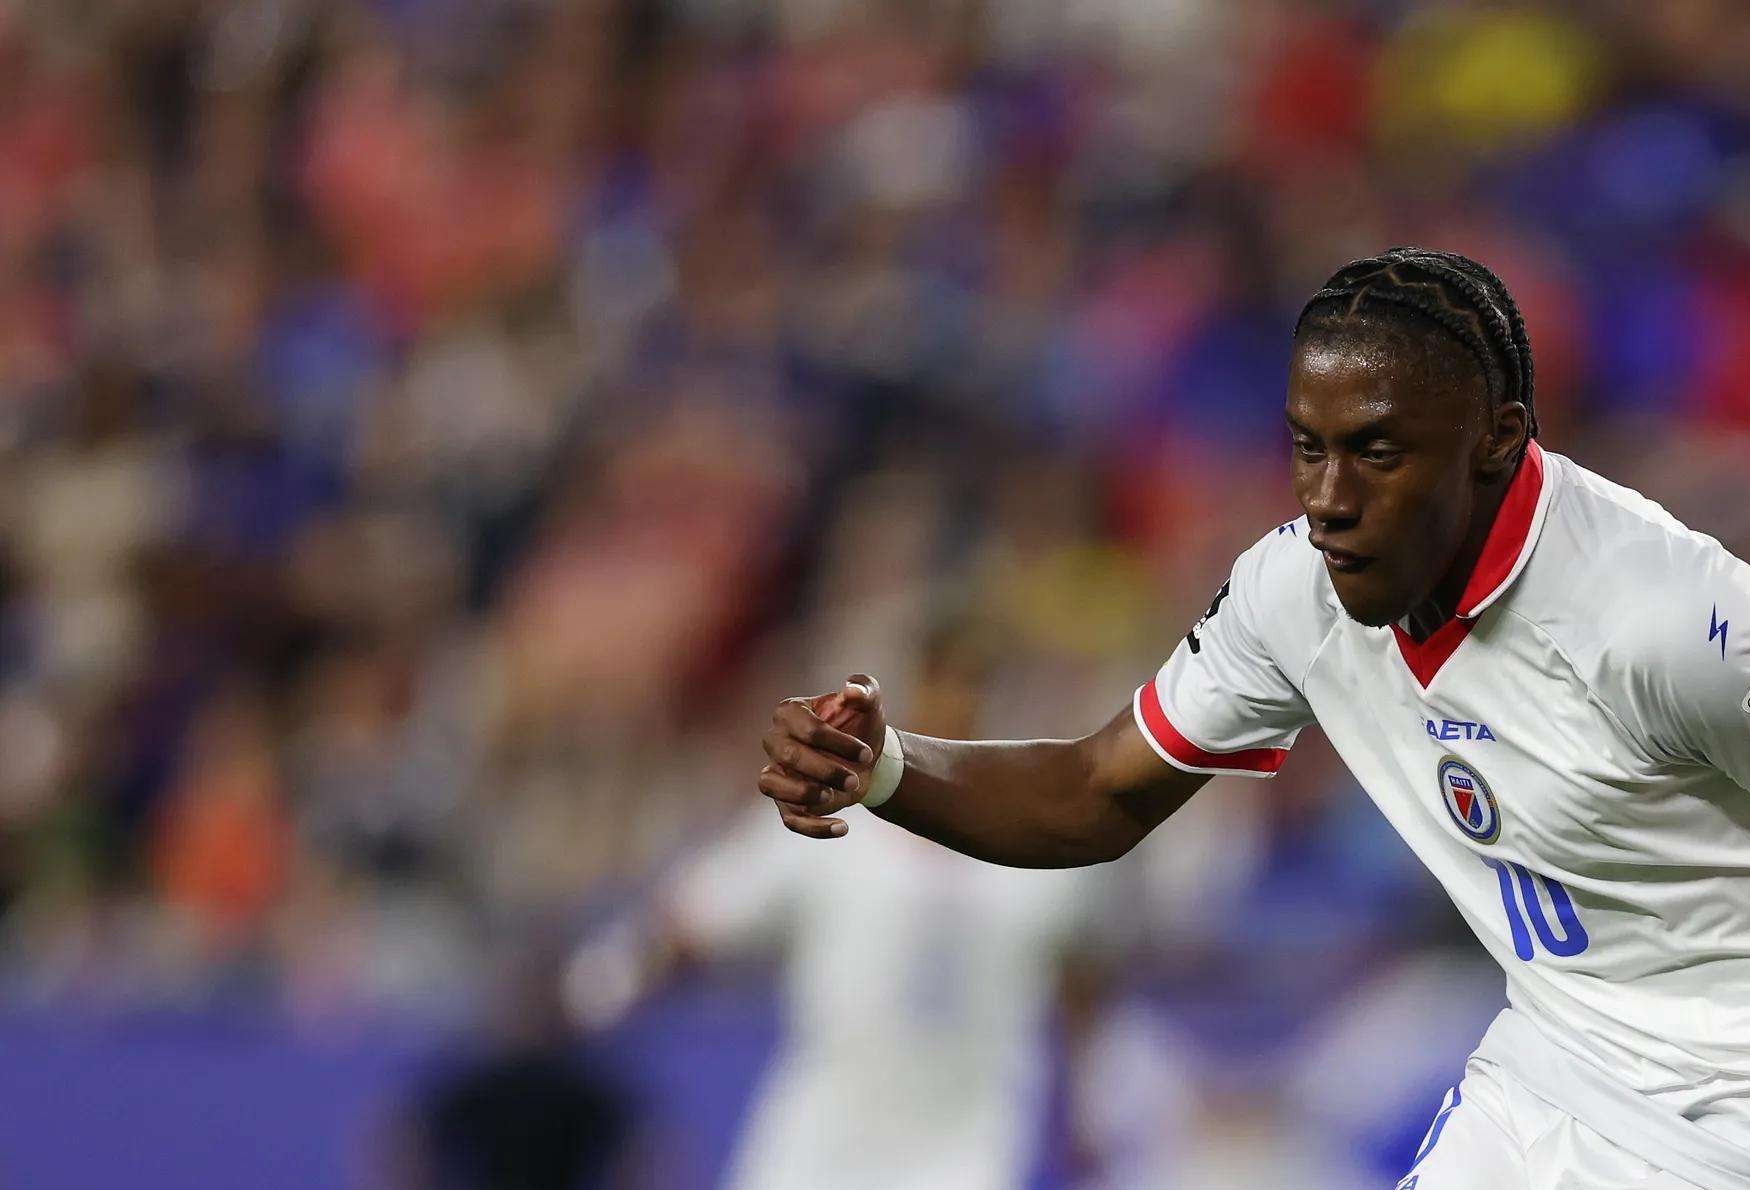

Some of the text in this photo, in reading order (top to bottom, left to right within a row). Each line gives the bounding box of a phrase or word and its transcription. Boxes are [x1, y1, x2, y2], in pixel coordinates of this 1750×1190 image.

[1421, 718, 1497, 742] AETA
[1450, 777, 1472, 788] HAITI
[1479, 854, 1590, 962] 10
